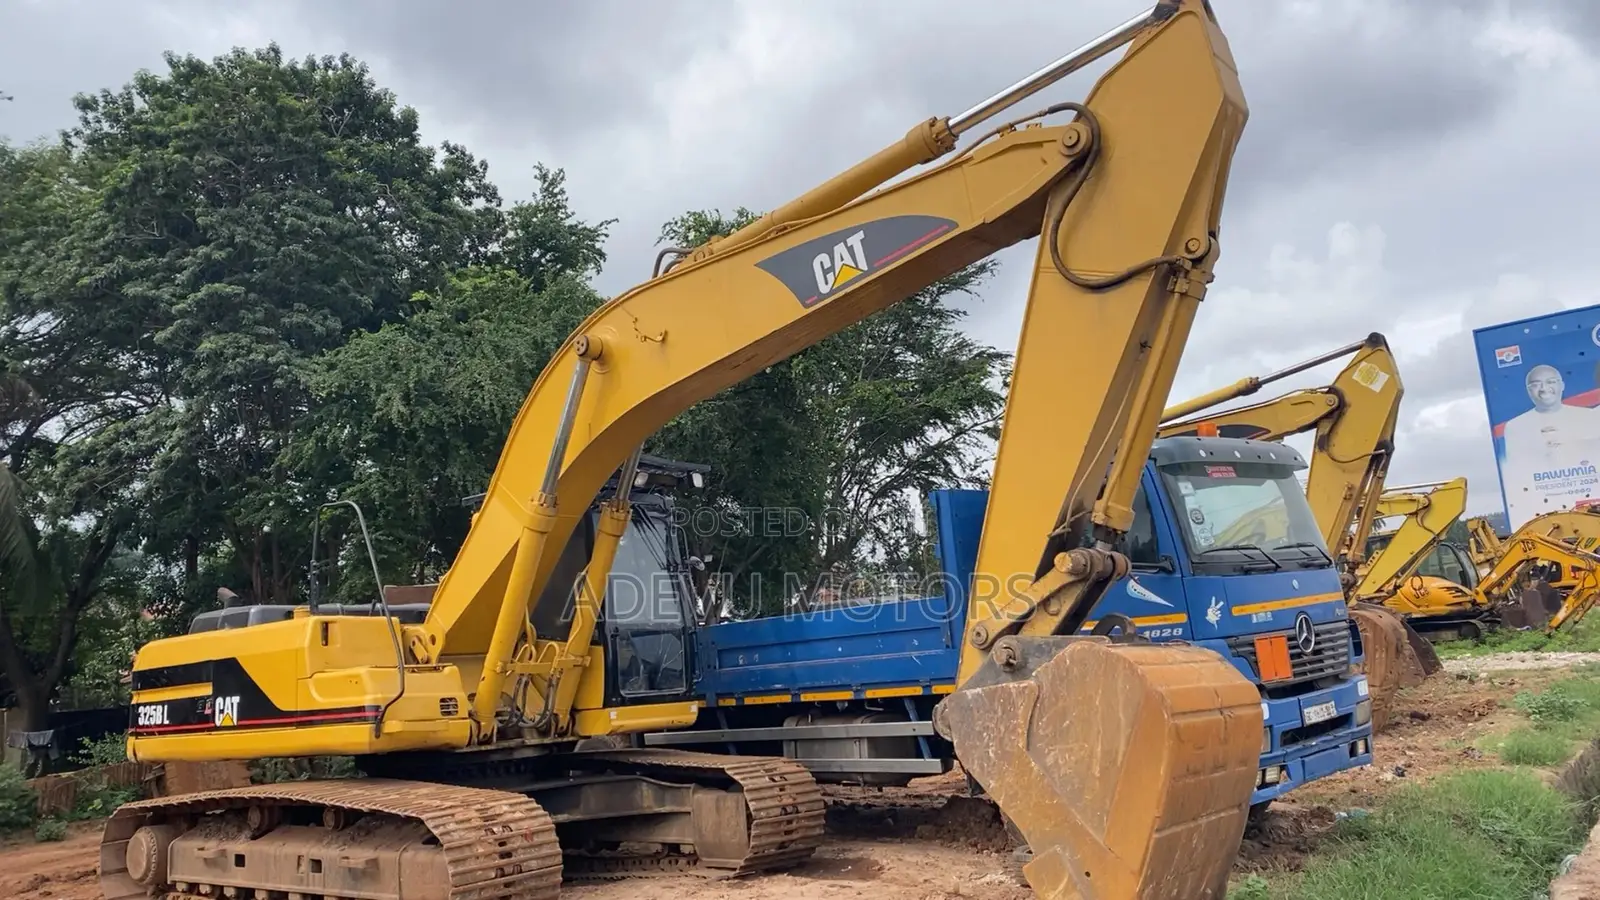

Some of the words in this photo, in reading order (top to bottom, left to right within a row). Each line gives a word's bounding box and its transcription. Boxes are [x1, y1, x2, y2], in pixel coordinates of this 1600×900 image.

[812, 230, 868, 295] CAT
[1533, 465, 1597, 482] BAWUMIA
[1143, 627, 1183, 638] 1828
[215, 696, 240, 727] CAT
